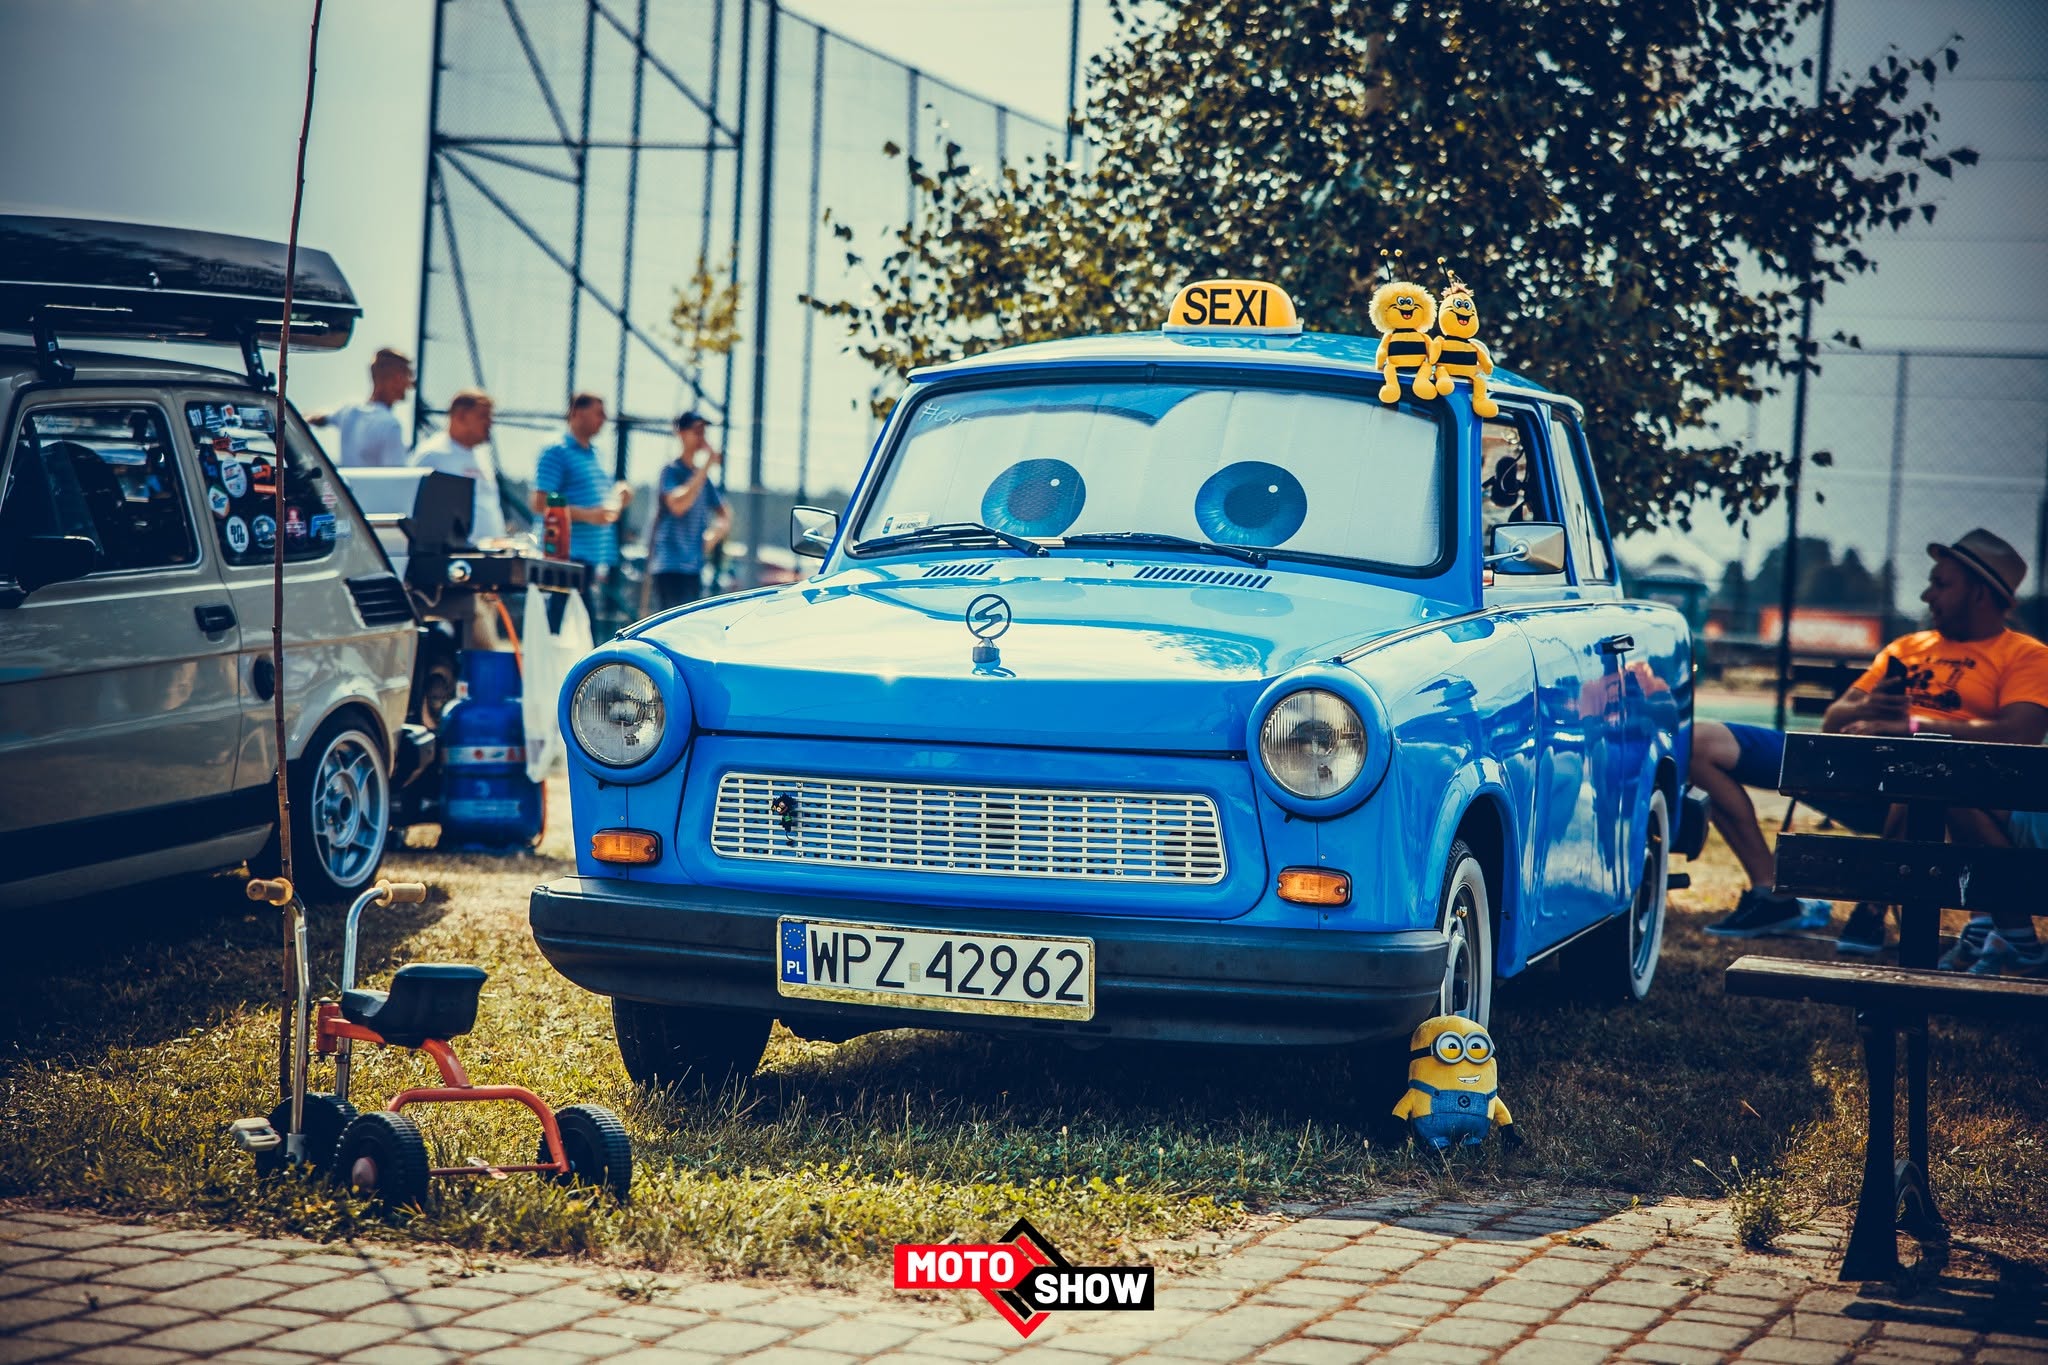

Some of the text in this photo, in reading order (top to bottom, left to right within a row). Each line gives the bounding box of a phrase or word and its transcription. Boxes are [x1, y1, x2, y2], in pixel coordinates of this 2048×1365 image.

[1182, 287, 1268, 327] SEXI
[786, 960, 804, 976] PL
[810, 930, 1084, 1002] WPZ 42962
